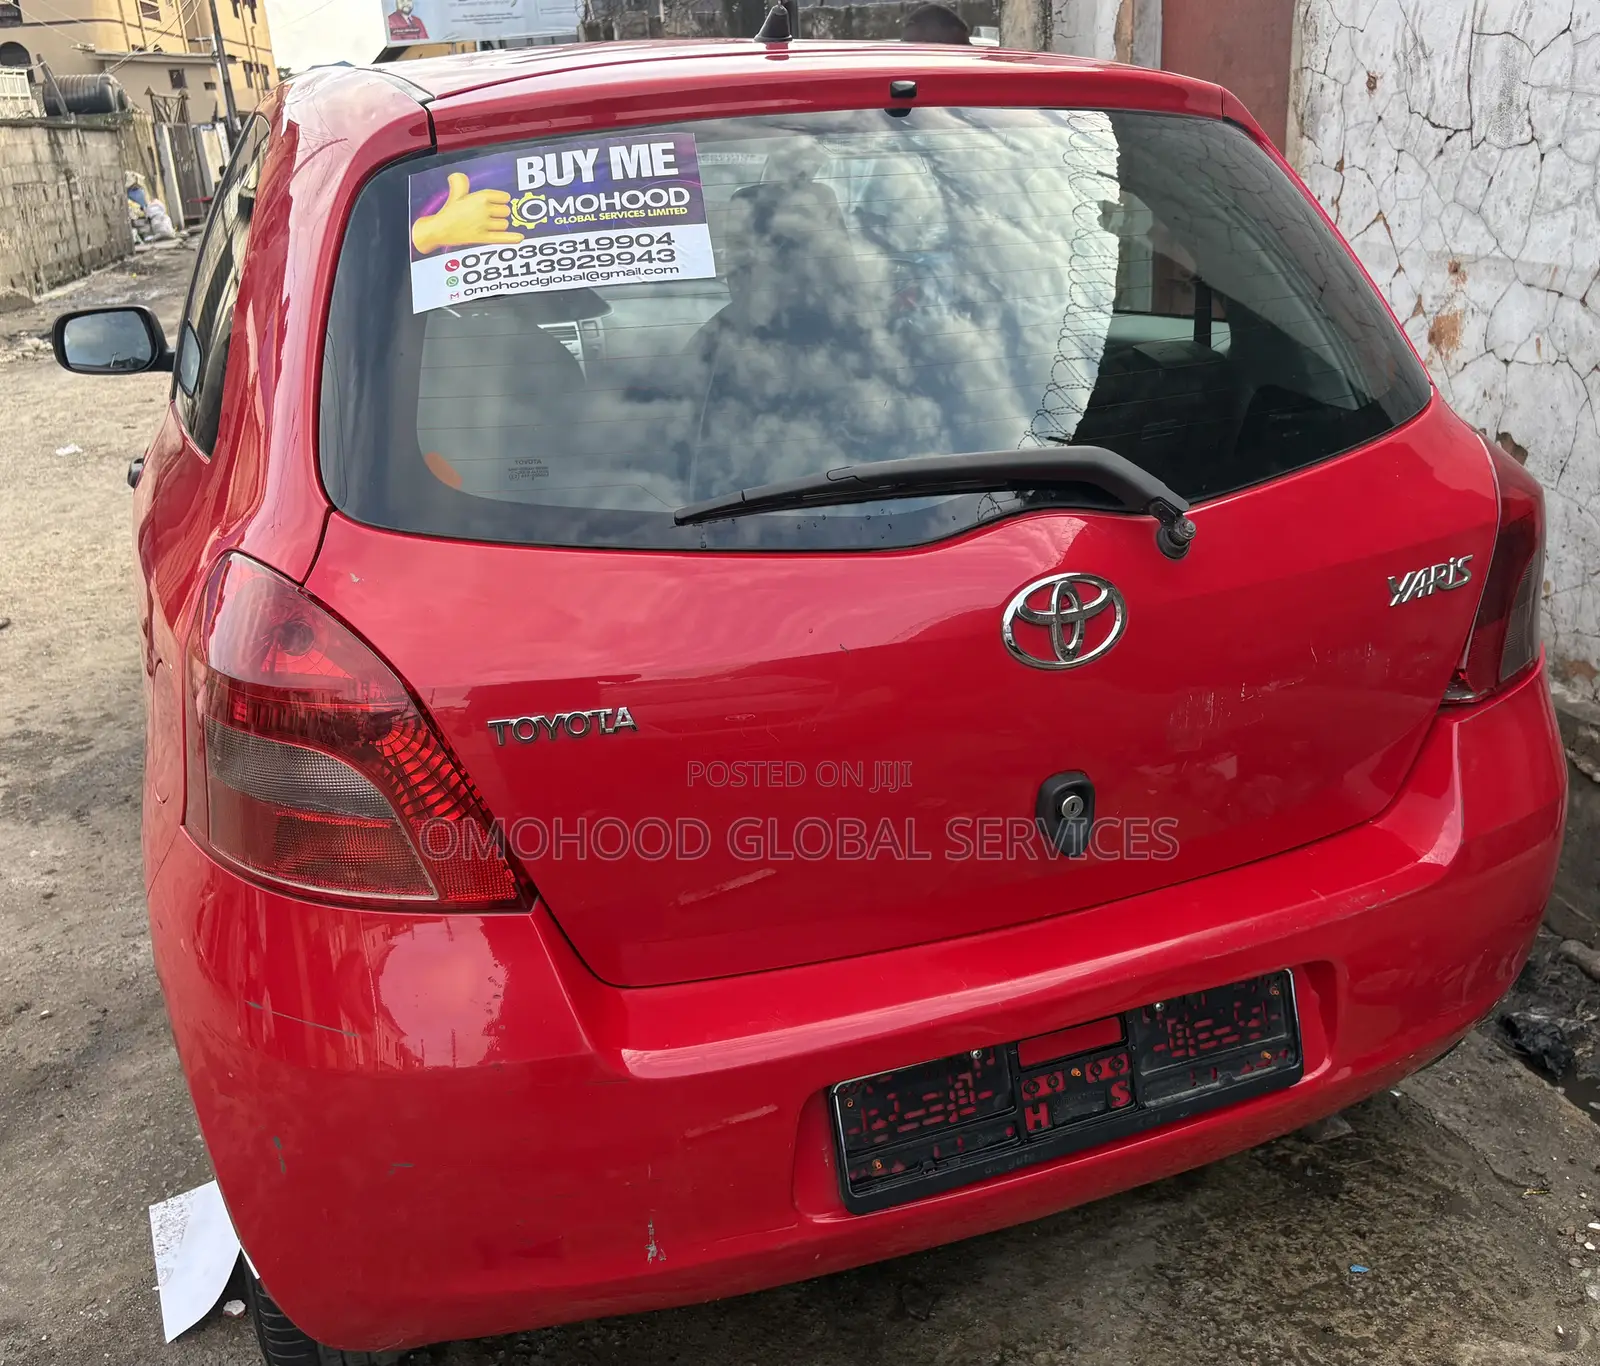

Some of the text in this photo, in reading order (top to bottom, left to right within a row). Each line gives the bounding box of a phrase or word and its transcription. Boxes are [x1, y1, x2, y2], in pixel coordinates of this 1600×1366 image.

[516, 142, 679, 191] BUY ME
[521, 187, 691, 220] OMOHOOD
[554, 207, 688, 225] GLOBAL SERVICES LIMITED
[461, 232, 676, 269] 07036319904
[462, 249, 677, 285] 08113929943
[487, 706, 638, 746] TOYOTA
